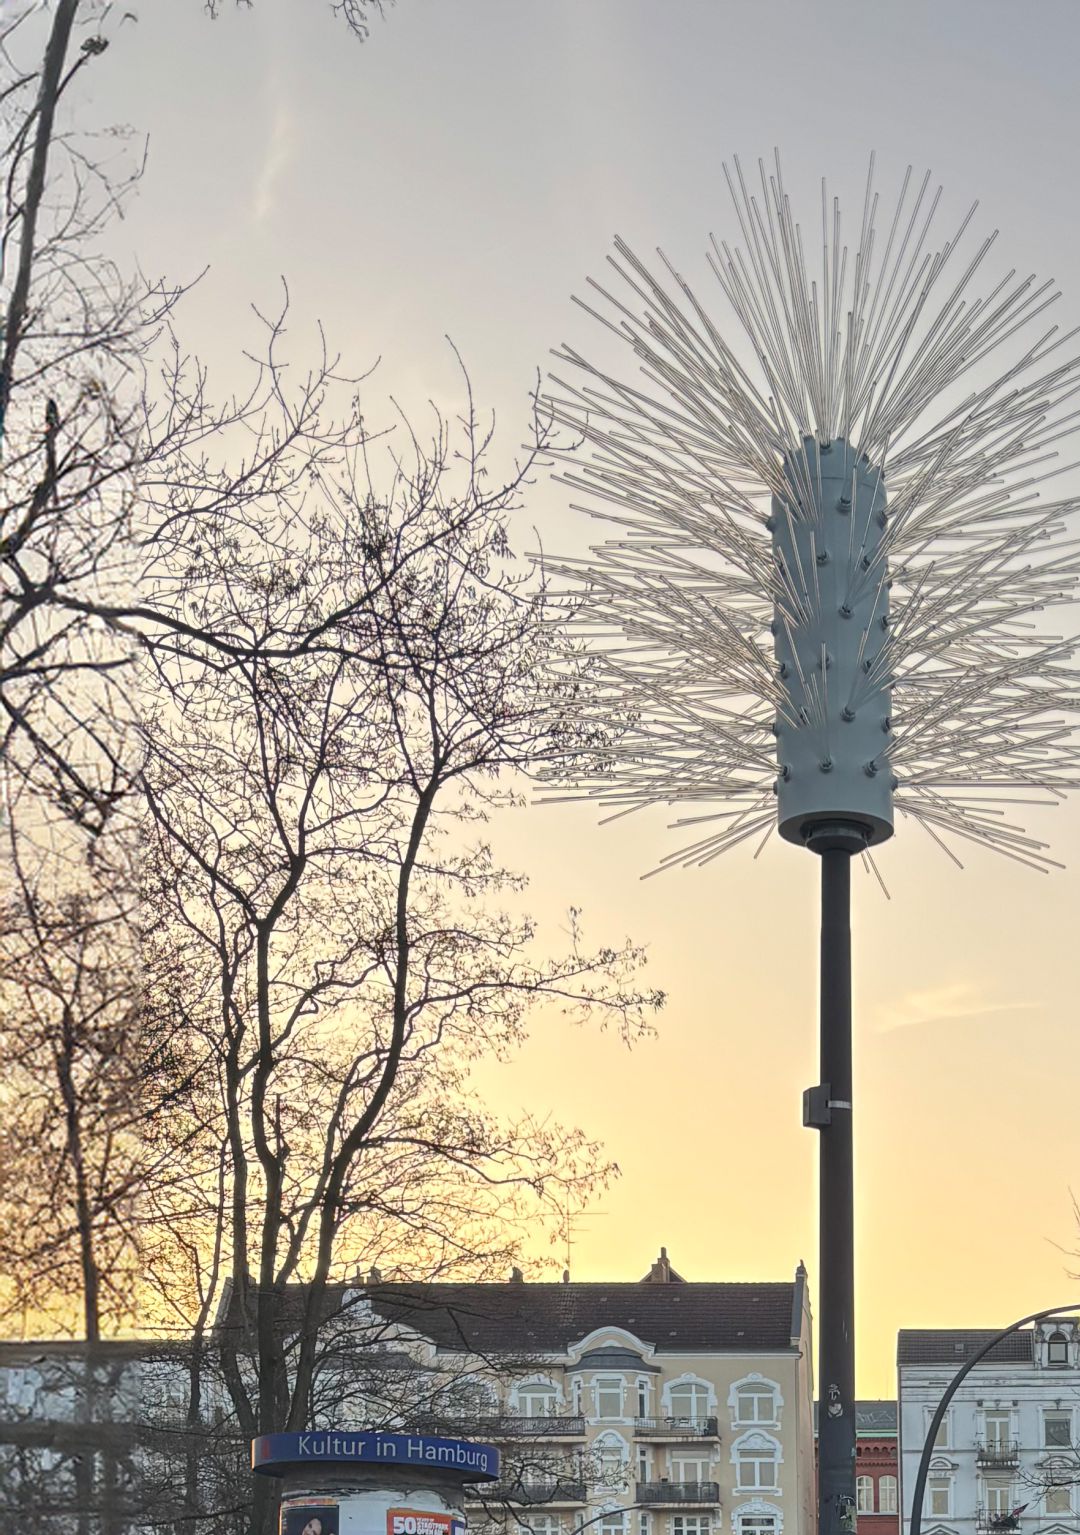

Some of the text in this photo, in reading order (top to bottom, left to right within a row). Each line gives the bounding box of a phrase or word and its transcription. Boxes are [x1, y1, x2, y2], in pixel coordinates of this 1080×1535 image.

[299, 1436, 488, 1472] Kultur in Hamburg
[393, 1516, 417, 1535] 50
